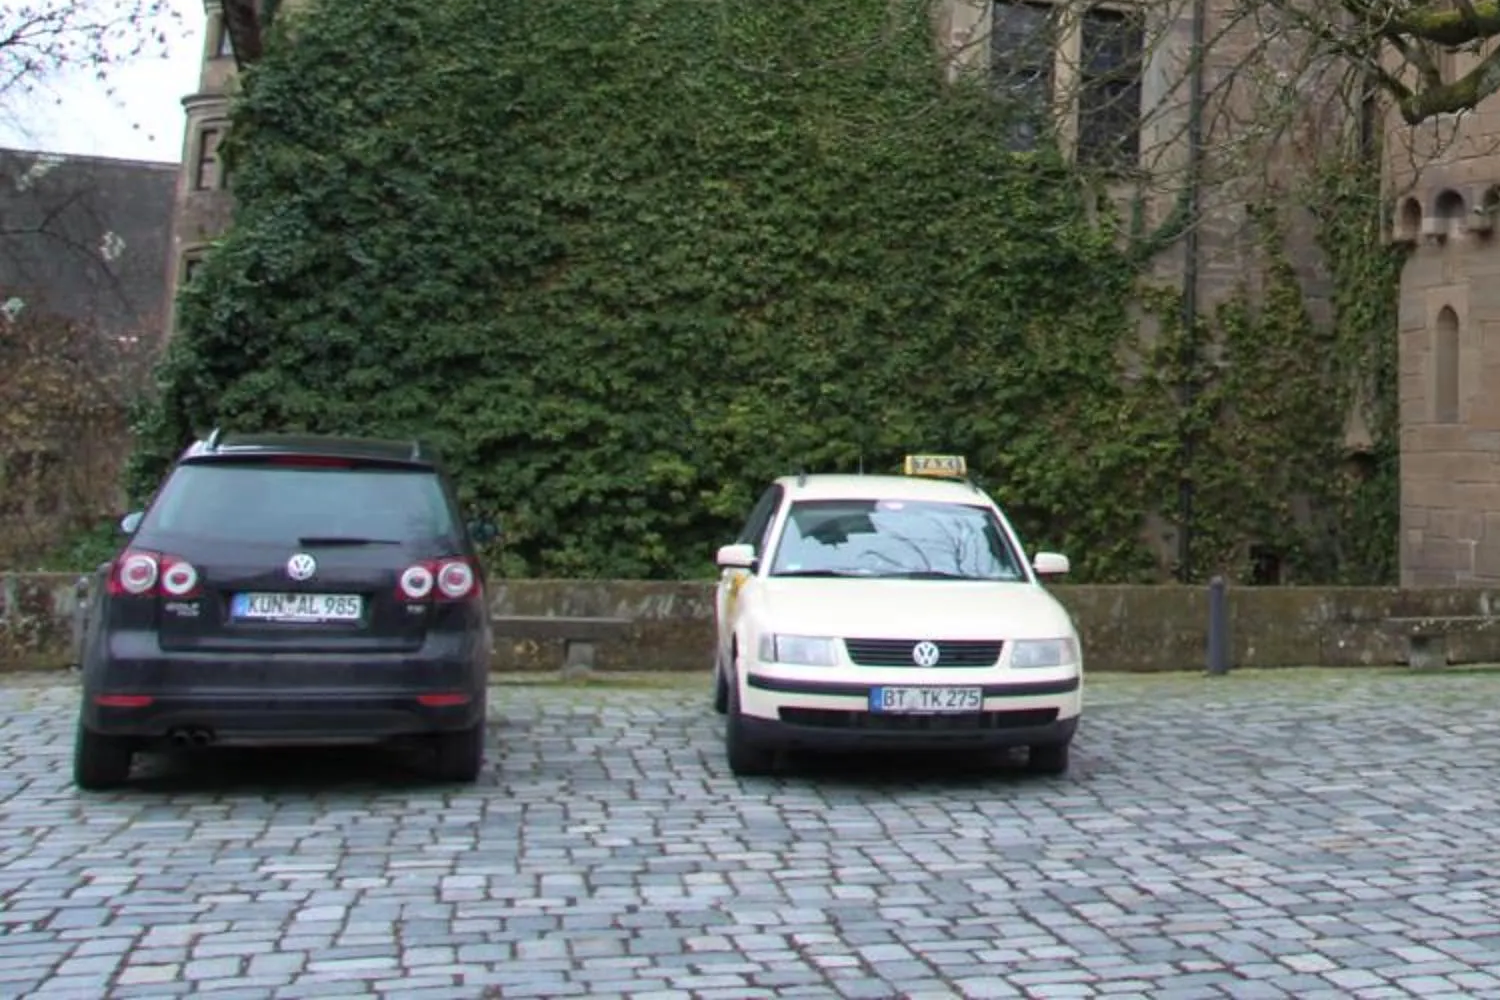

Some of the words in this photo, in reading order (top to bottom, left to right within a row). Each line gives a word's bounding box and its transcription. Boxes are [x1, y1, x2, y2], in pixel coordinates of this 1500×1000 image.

[883, 689, 908, 706] BT
[920, 689, 942, 706] TK
[946, 689, 979, 706] 275
